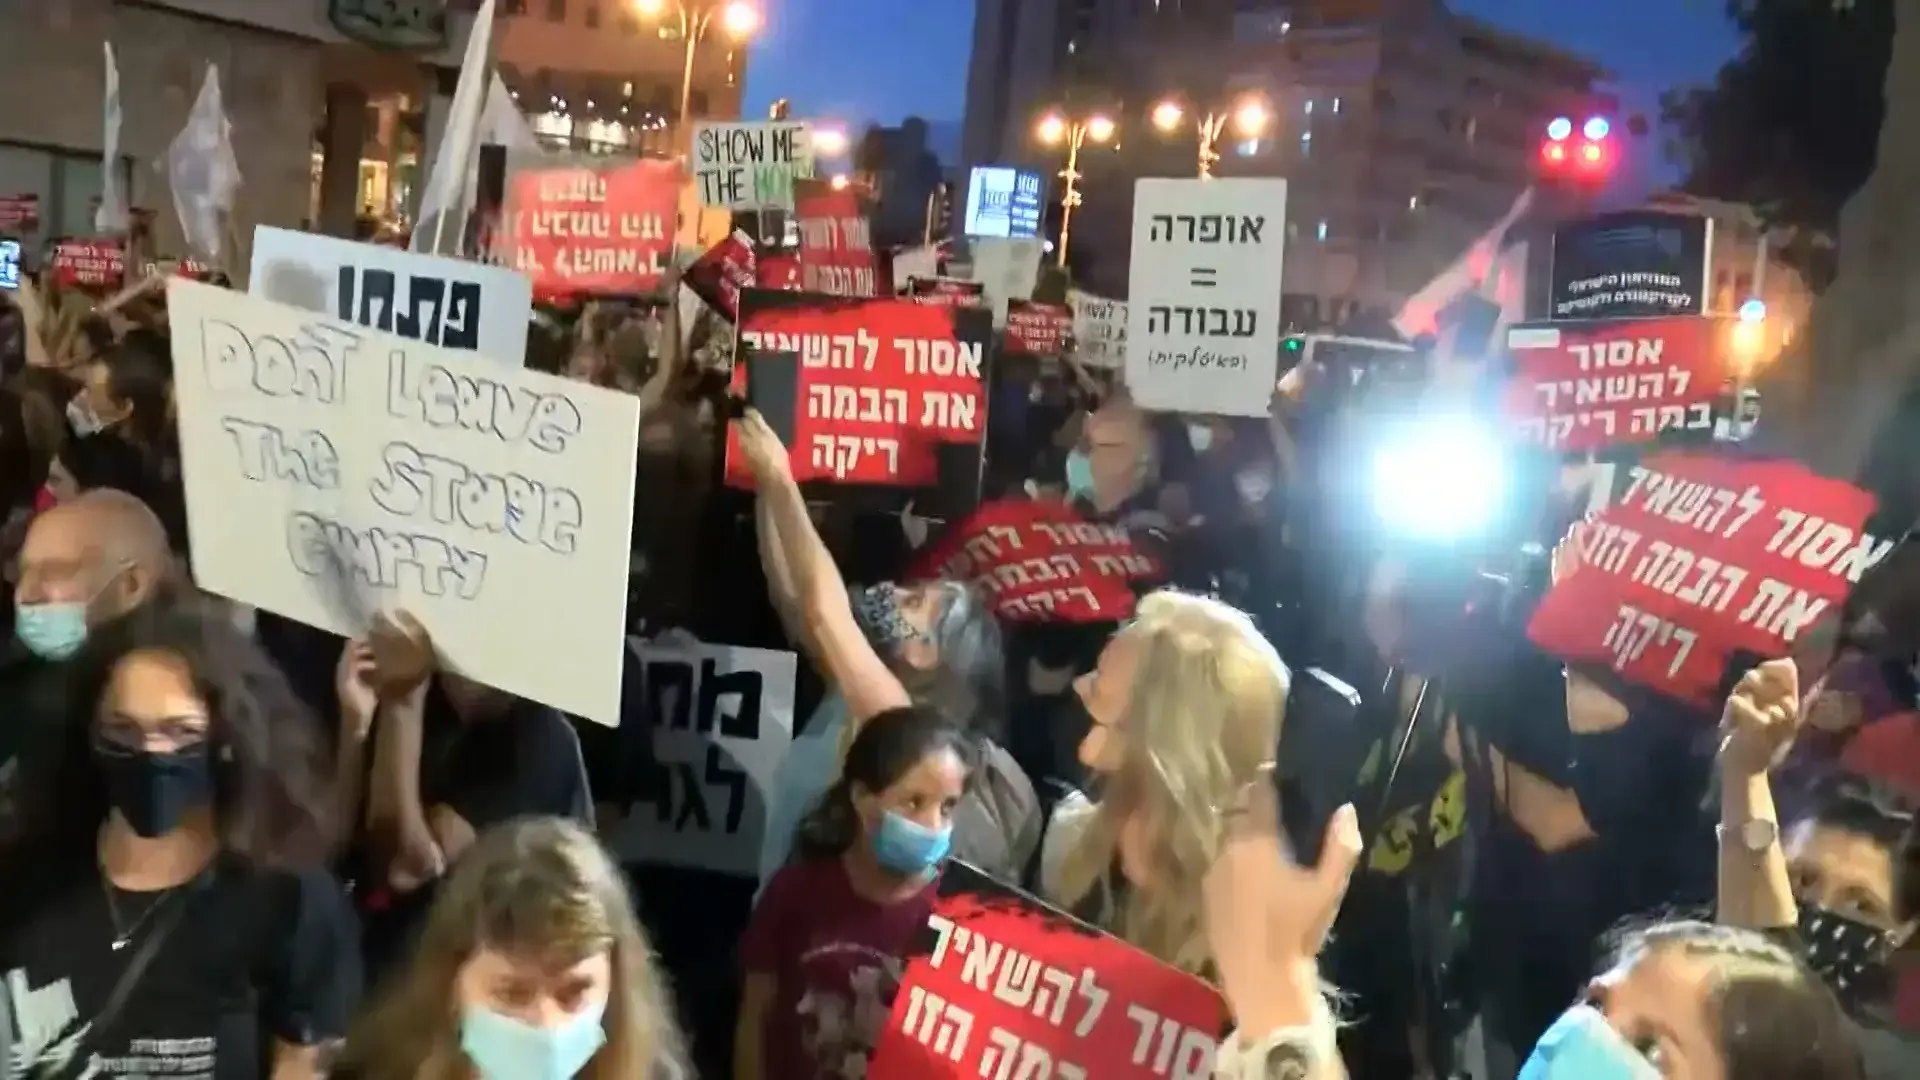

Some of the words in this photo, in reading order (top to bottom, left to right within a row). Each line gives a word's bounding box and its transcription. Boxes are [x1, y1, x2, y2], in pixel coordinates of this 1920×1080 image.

[700, 129, 764, 164] SHOW
[772, 127, 804, 162] ME
[697, 168, 744, 205] THE
[1150, 214, 1266, 245] אופרה
[1190, 267, 1217, 287] =
[338, 265, 482, 351] פתחו
[1148, 305, 1257, 339] עבודה
[894, 337, 982, 378] אסור
[1566, 337, 1664, 371] אסור
[808, 383, 908, 425] הבמה
[1534, 364, 1692, 407] להשאיר
[921, 390, 976, 430] את
[1630, 400, 1712, 434] במה
[812, 433, 900, 479] ריקה
[1620, 465, 1767, 539] להשאיר
[1032, 521, 1132, 546] אסור
[1766, 507, 1896, 583] אסור
[1090, 553, 1154, 577] את
[1631, 539, 1750, 613] הבמה
[1738, 577, 1830, 641] את
[1602, 604, 1699, 680] ריקה
[926, 913, 1109, 1037] להשאיר
[902, 985, 974, 1064] הזו
[1127, 1003, 1216, 1080] סור
